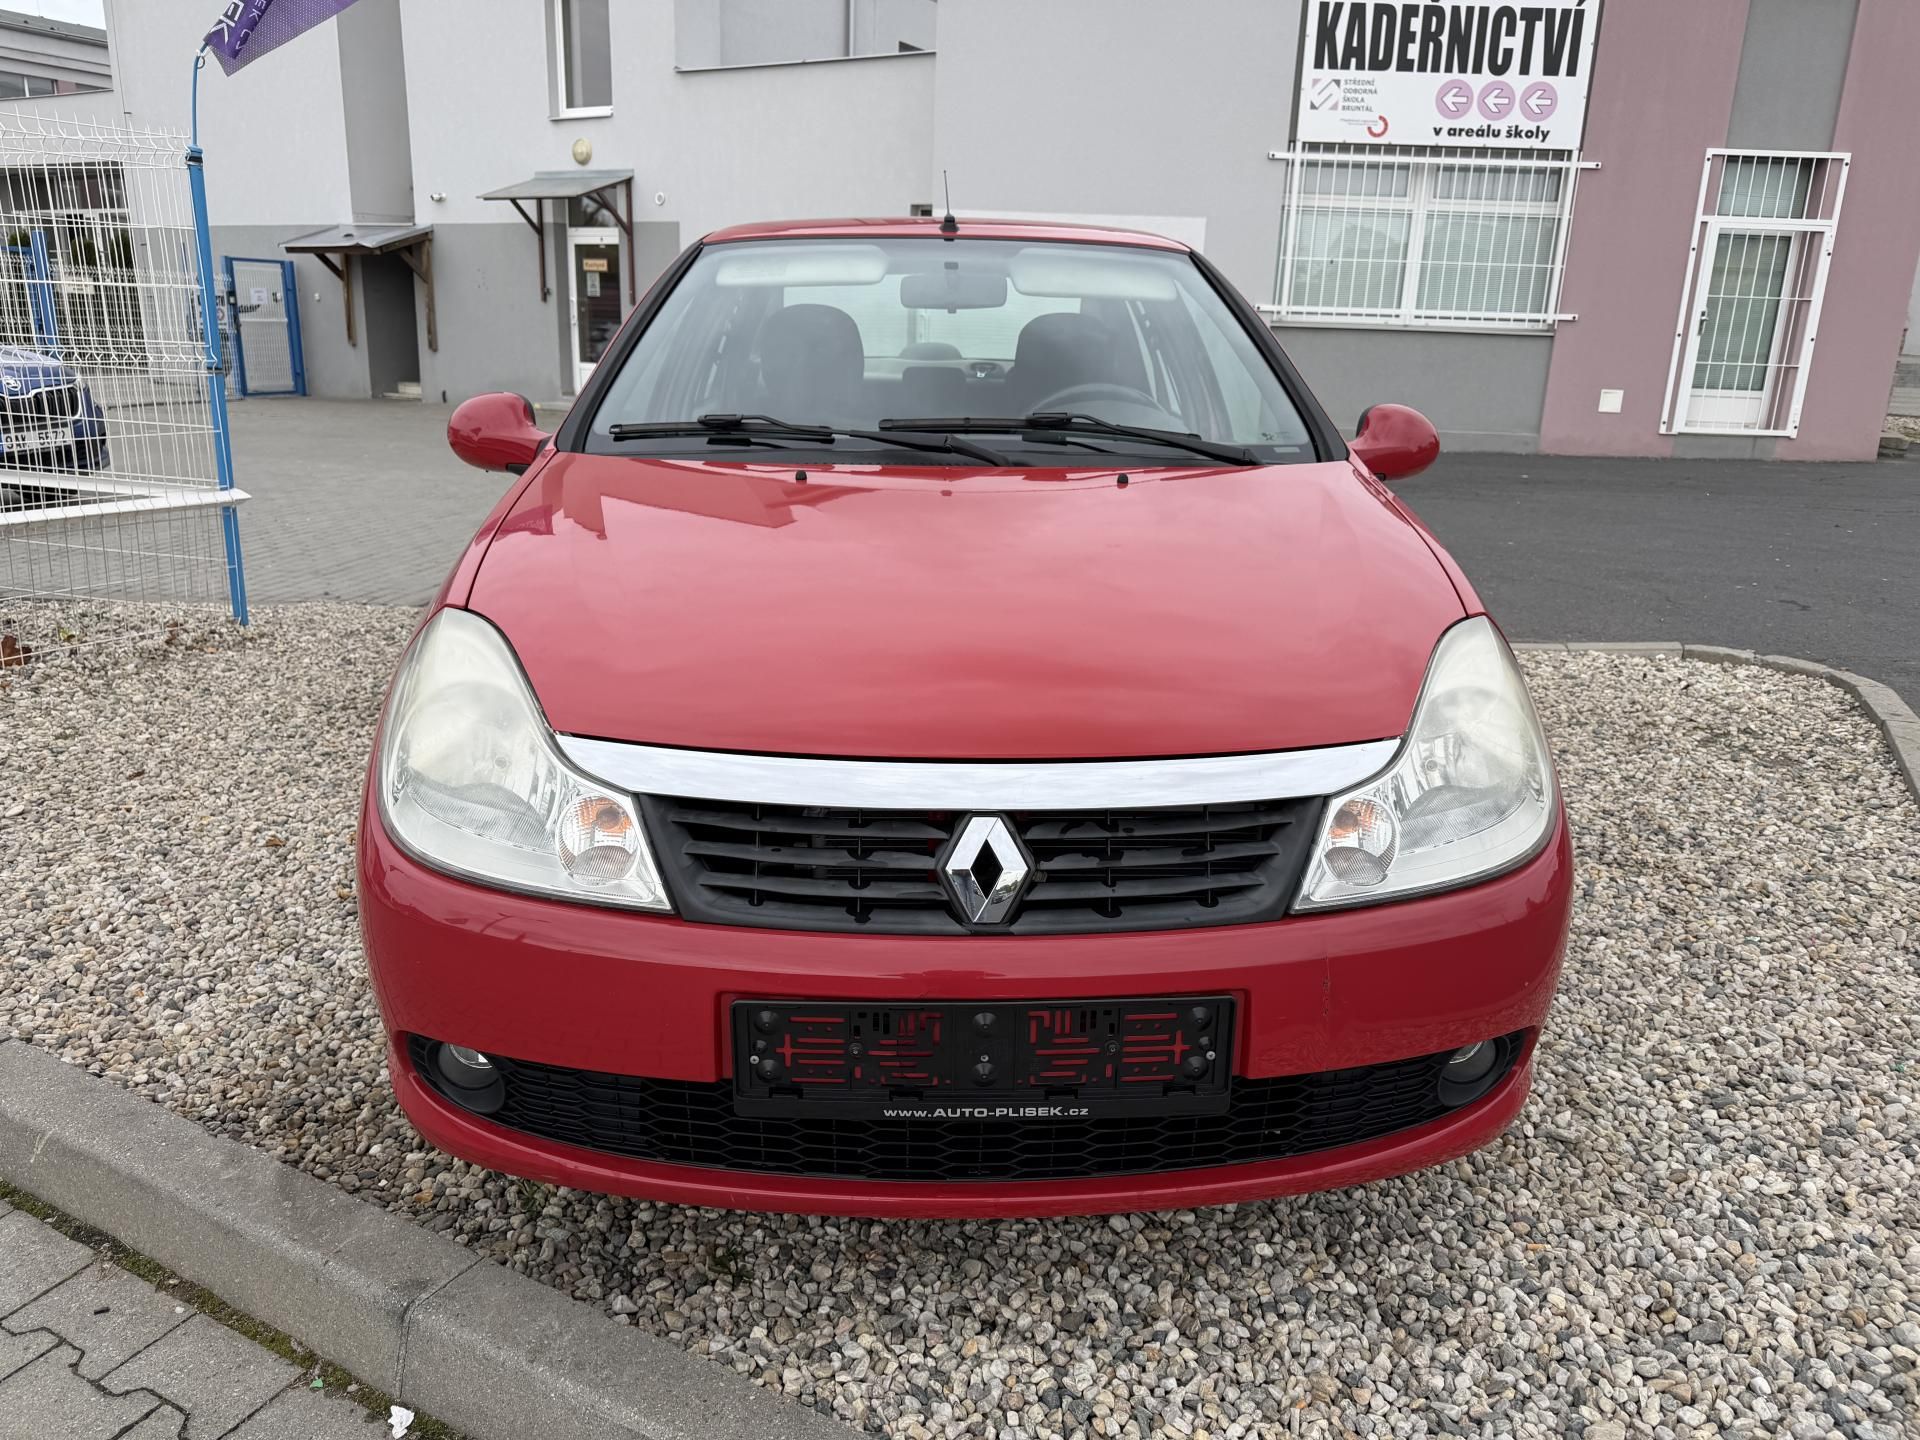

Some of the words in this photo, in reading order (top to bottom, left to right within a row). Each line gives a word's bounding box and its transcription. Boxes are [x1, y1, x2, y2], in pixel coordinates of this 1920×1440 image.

[1313, 0, 1586, 76] KADEŘNICTVÍ
[1344, 77, 1375, 86] STŘEDNÍ
[1343, 87, 1377, 95] ODBORNÁ
[1343, 95, 1365, 103] ŠKOLA
[1433, 127, 1443, 136] v
[1447, 124, 1501, 138] areálu
[1505, 125, 1550, 143] školy
[883, 1107, 1089, 1118] www.AUTO-PLISEK.cz
